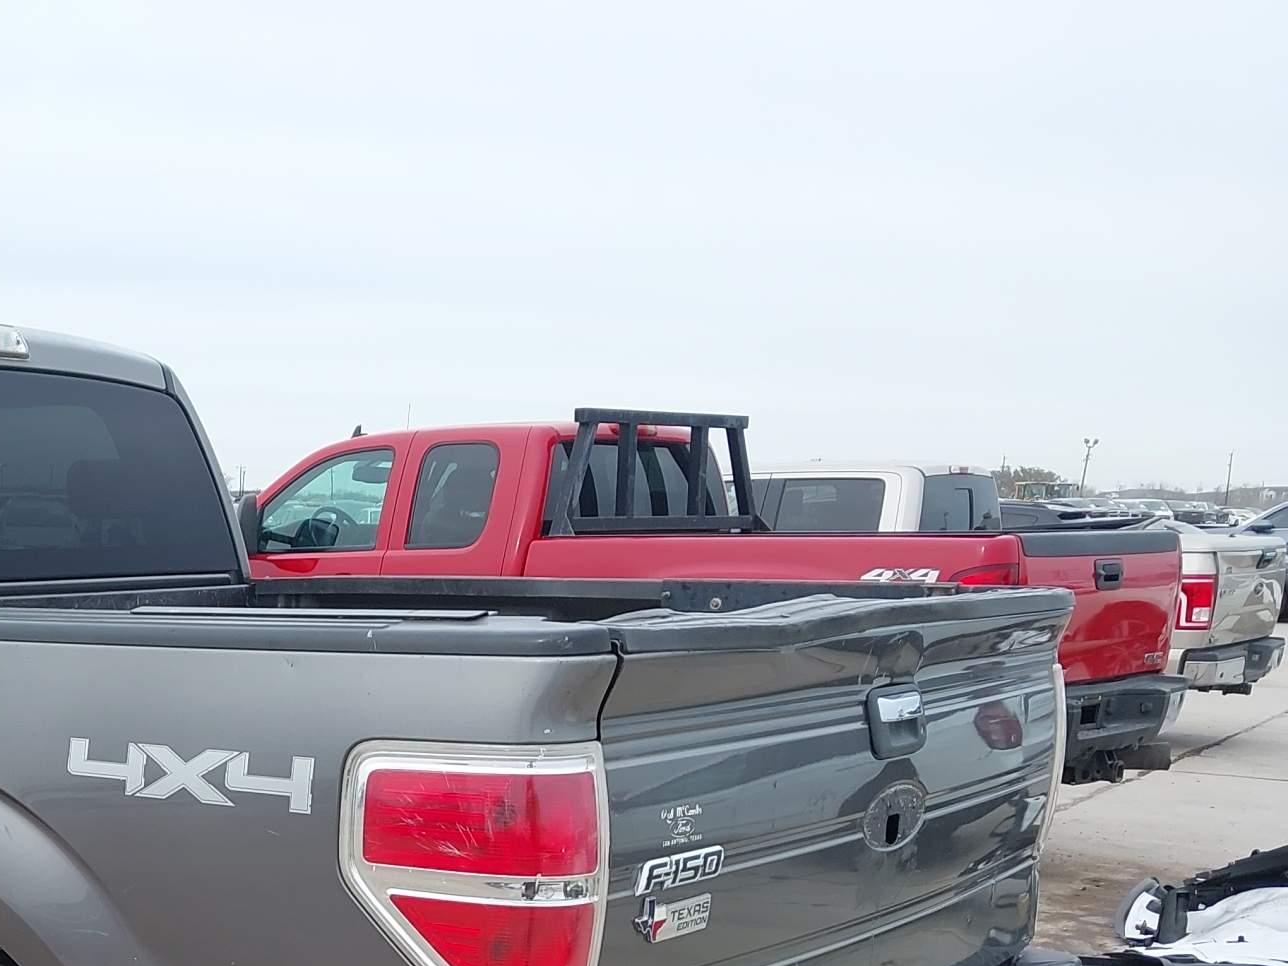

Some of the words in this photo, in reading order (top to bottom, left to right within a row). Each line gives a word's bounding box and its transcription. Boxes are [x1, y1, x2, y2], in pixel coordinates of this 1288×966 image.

[635, 845, 724, 896] F-150
[671, 901, 709, 923] TEXAS
[677, 916, 707, 931] EDITION
